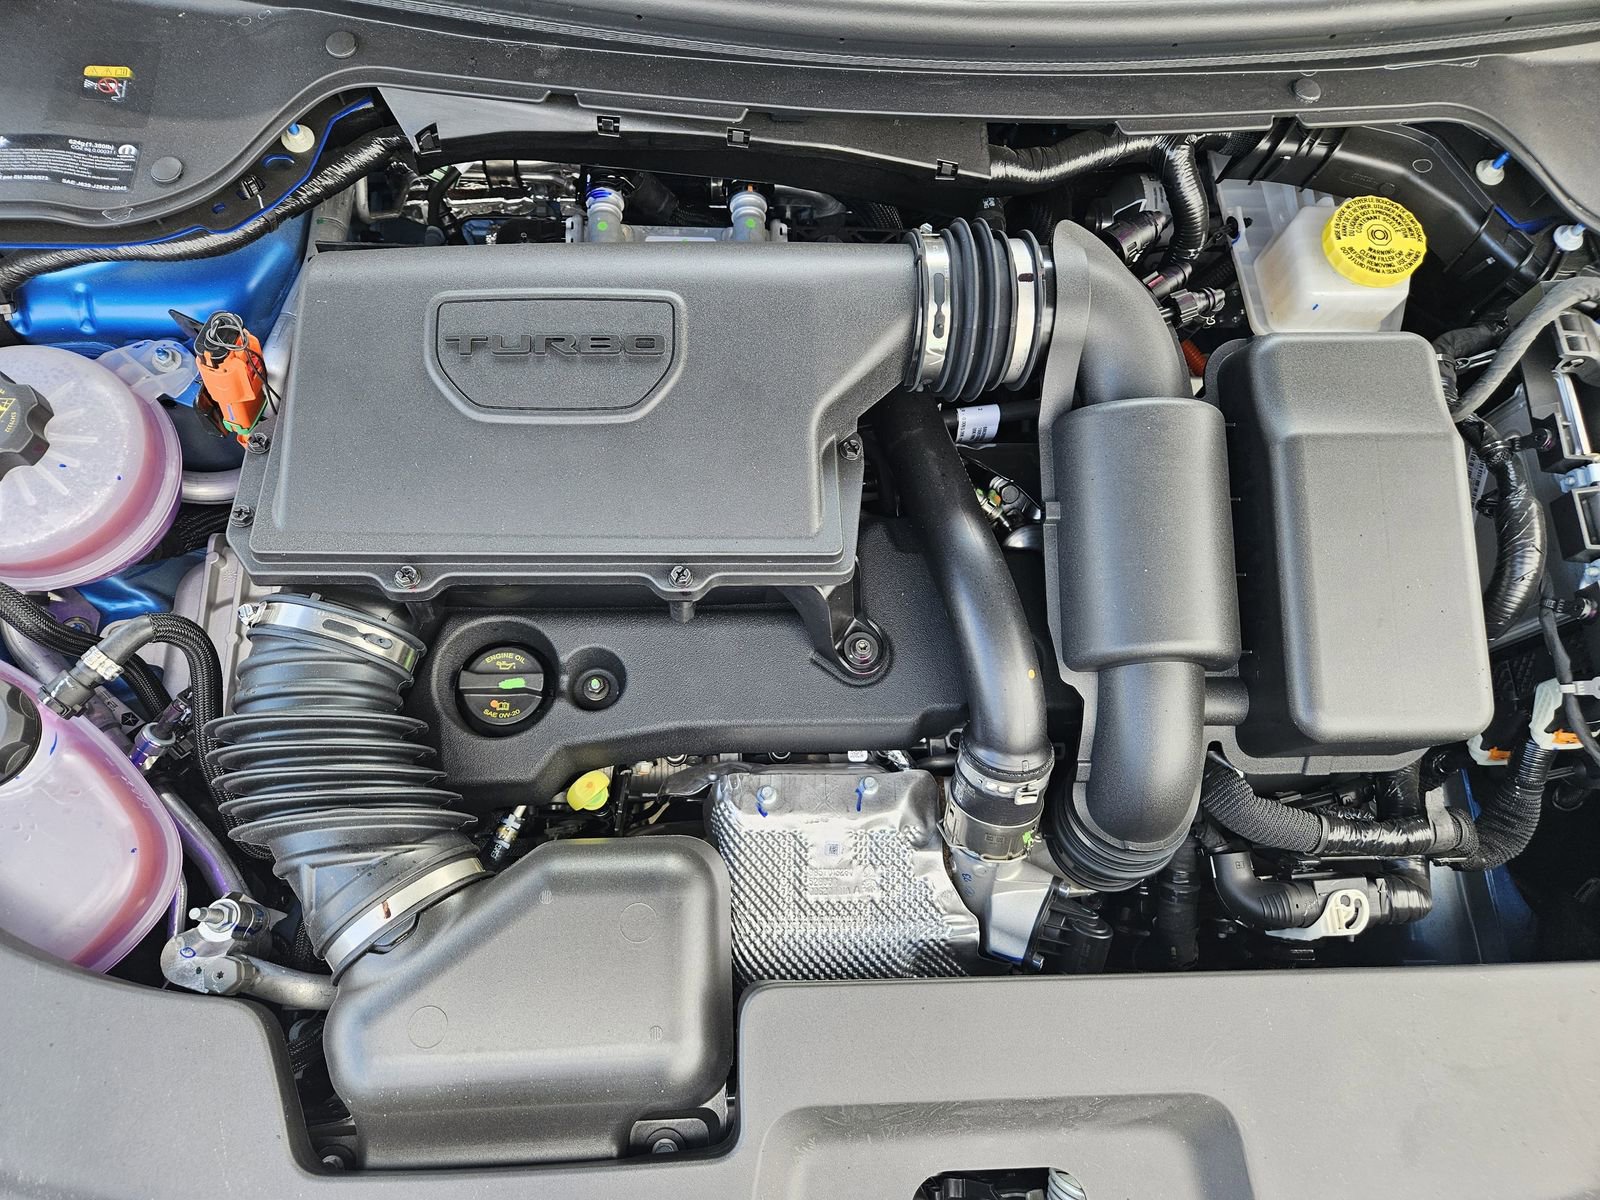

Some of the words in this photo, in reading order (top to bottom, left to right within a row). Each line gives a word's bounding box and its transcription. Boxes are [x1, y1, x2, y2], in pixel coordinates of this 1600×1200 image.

[1340, 246, 1350, 255] DOT
[1365, 265, 1381, 273] FROM
[1347, 246, 1365, 262] BEFORE
[1359, 249, 1376, 260] CLEAN
[445, 334, 666, 357] TURBO
[485, 653, 513, 663] ENGINE
[515, 654, 526, 664] OIL
[483, 708, 498, 718] SAE
[499, 709, 521, 719] 0W-20
